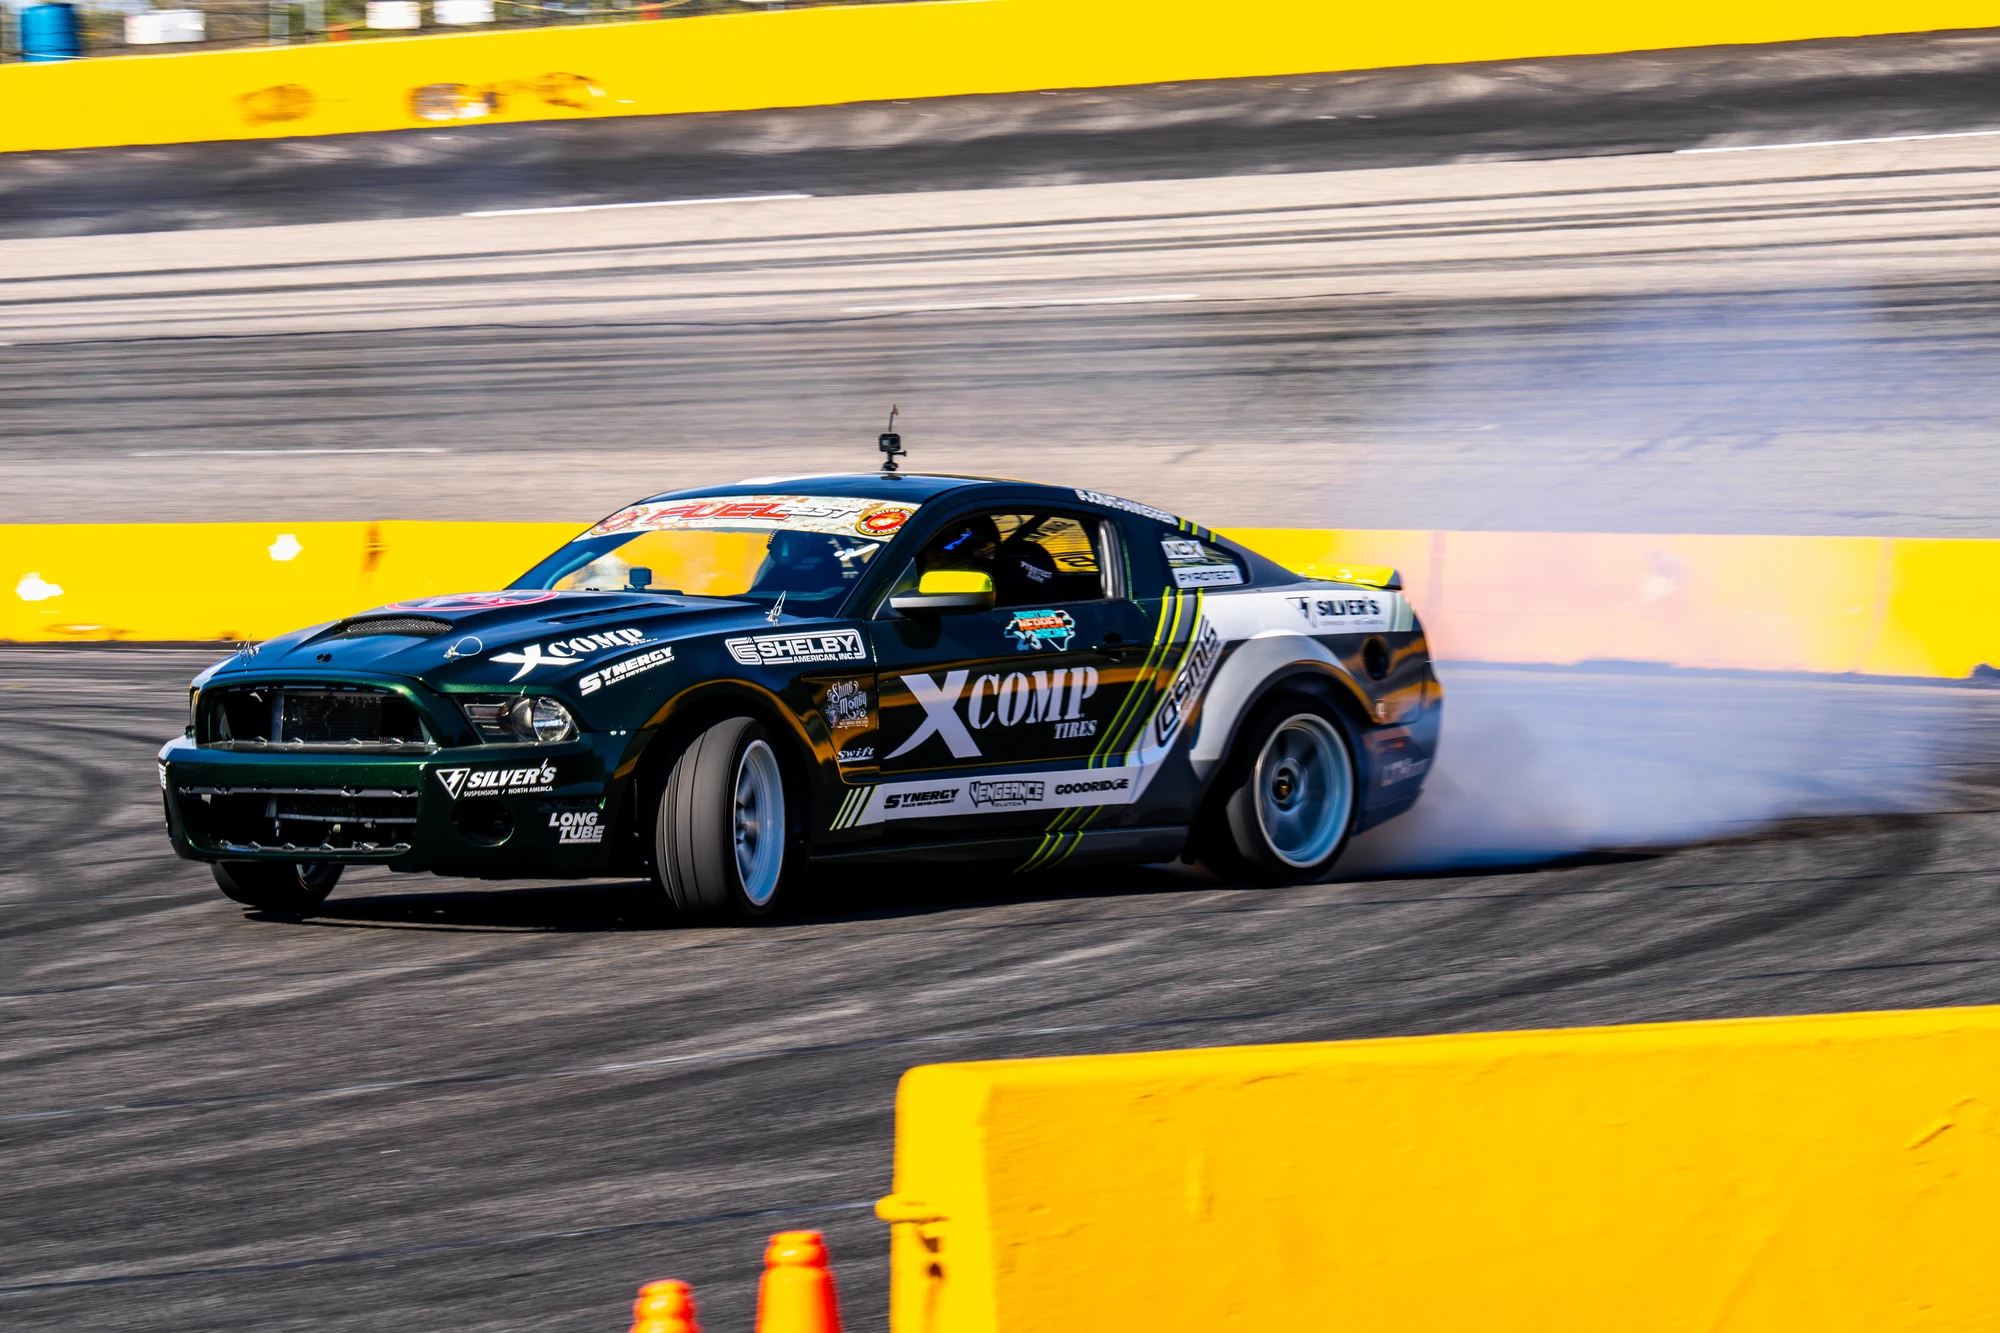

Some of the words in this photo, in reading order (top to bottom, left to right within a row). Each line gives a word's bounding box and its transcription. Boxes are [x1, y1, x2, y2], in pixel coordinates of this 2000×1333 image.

[756, 635, 857, 658] SHELBY
[792, 653, 840, 664] AMERICAN,
[838, 651, 857, 661] INC.
[578, 646, 673, 696] SYNERGY
[1053, 719, 1098, 740] TIRES
[466, 758, 557, 789] SILVER'S
[463, 790, 499, 798] SUSPENSION
[508, 787, 529, 795] NORTH
[528, 785, 553, 793] AMERICA
[968, 780, 1045, 808] VENGEANCE
[1055, 778, 1130, 795] GOODRIDGE
[883, 788, 960, 810] SYNERGY
[548, 812, 599, 827] LONG
[558, 824, 606, 840] TUBE
